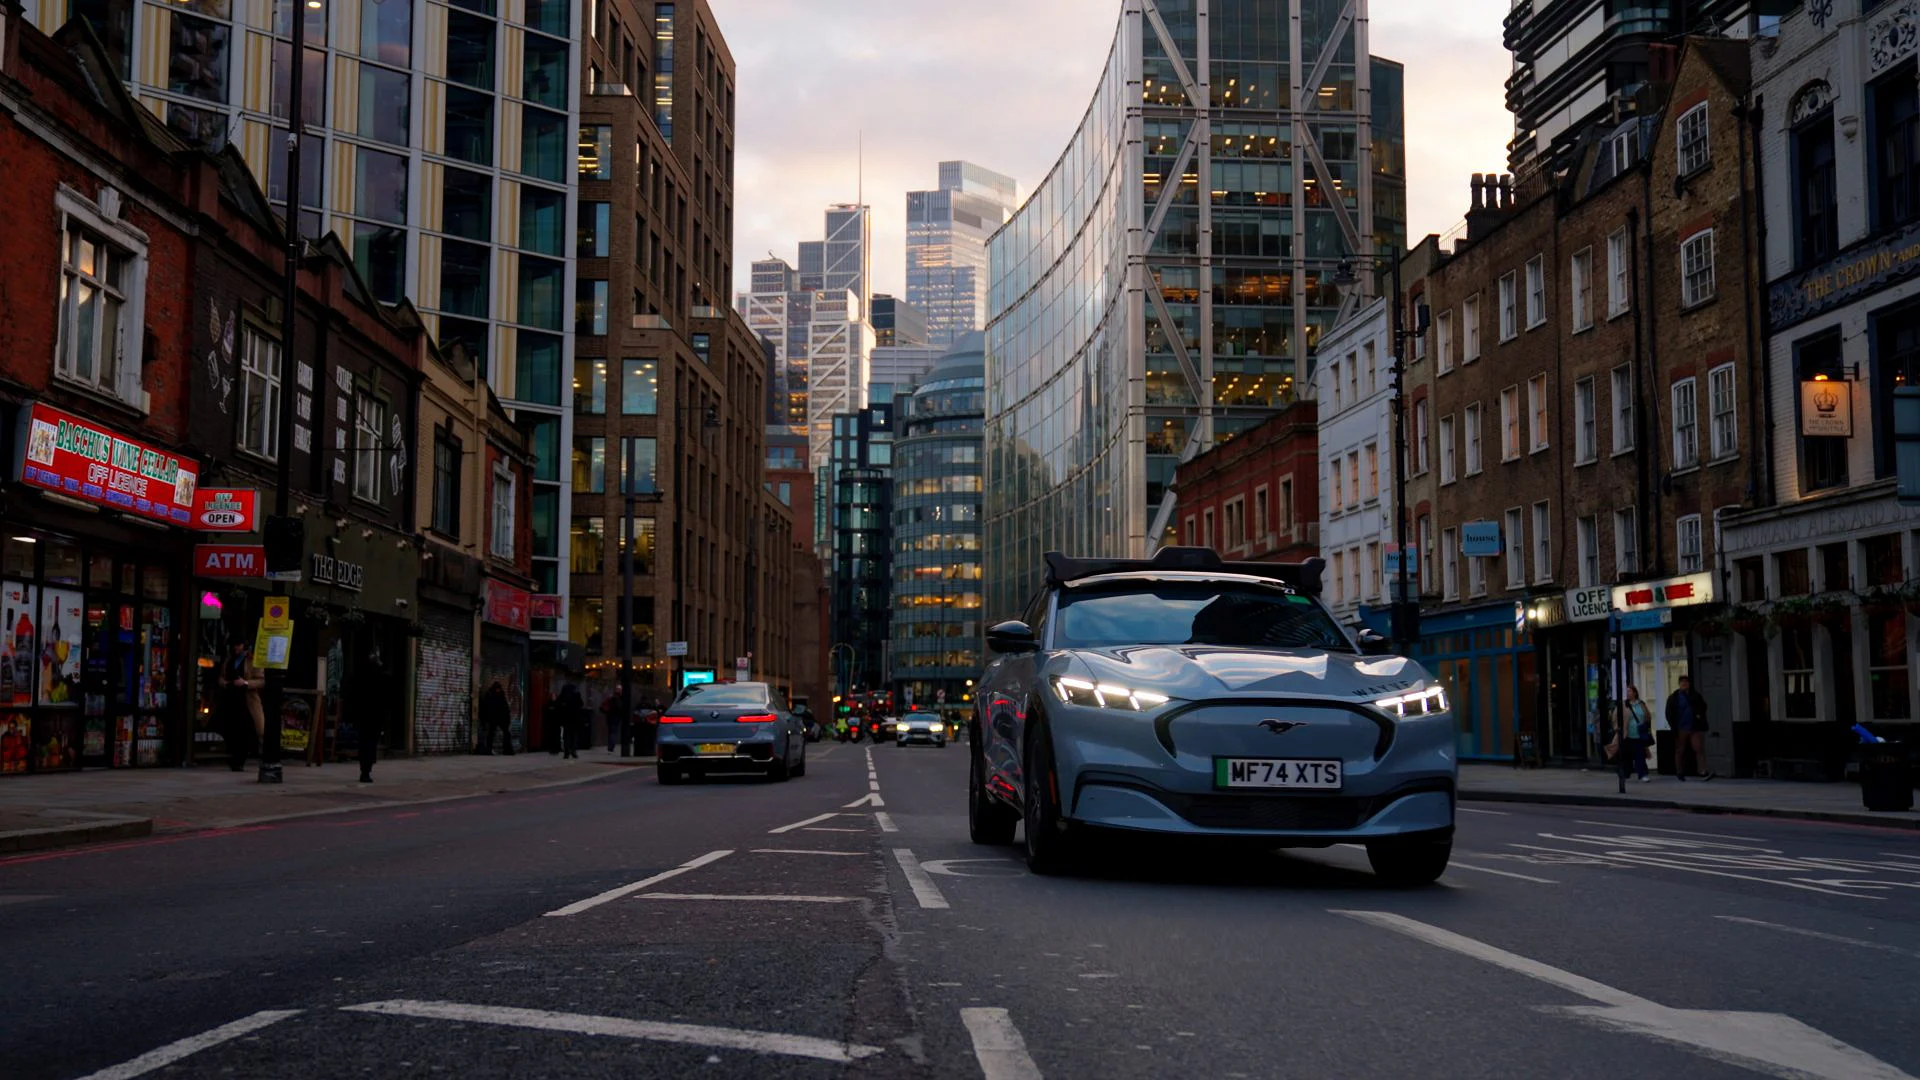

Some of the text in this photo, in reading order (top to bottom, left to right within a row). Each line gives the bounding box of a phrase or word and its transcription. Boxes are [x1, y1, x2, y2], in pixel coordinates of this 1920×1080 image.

[1805, 243, 1920, 303] THE CROWN AND
[56, 419, 180, 485] BACCHUS WINE CELLAR
[87, 463, 110, 486] OFF
[108, 468, 148, 497] LICENCE
[208, 513, 236, 523] OPEN
[1466, 533, 1497, 543] house
[205, 552, 254, 569] ATM
[1387, 553, 1413, 561] hose
[312, 553, 364, 588] THE EDGE
[1576, 589, 1606, 604] OFF
[1572, 600, 1613, 617] LICENCE
[1232, 761, 1337, 784] MF74 XTS
